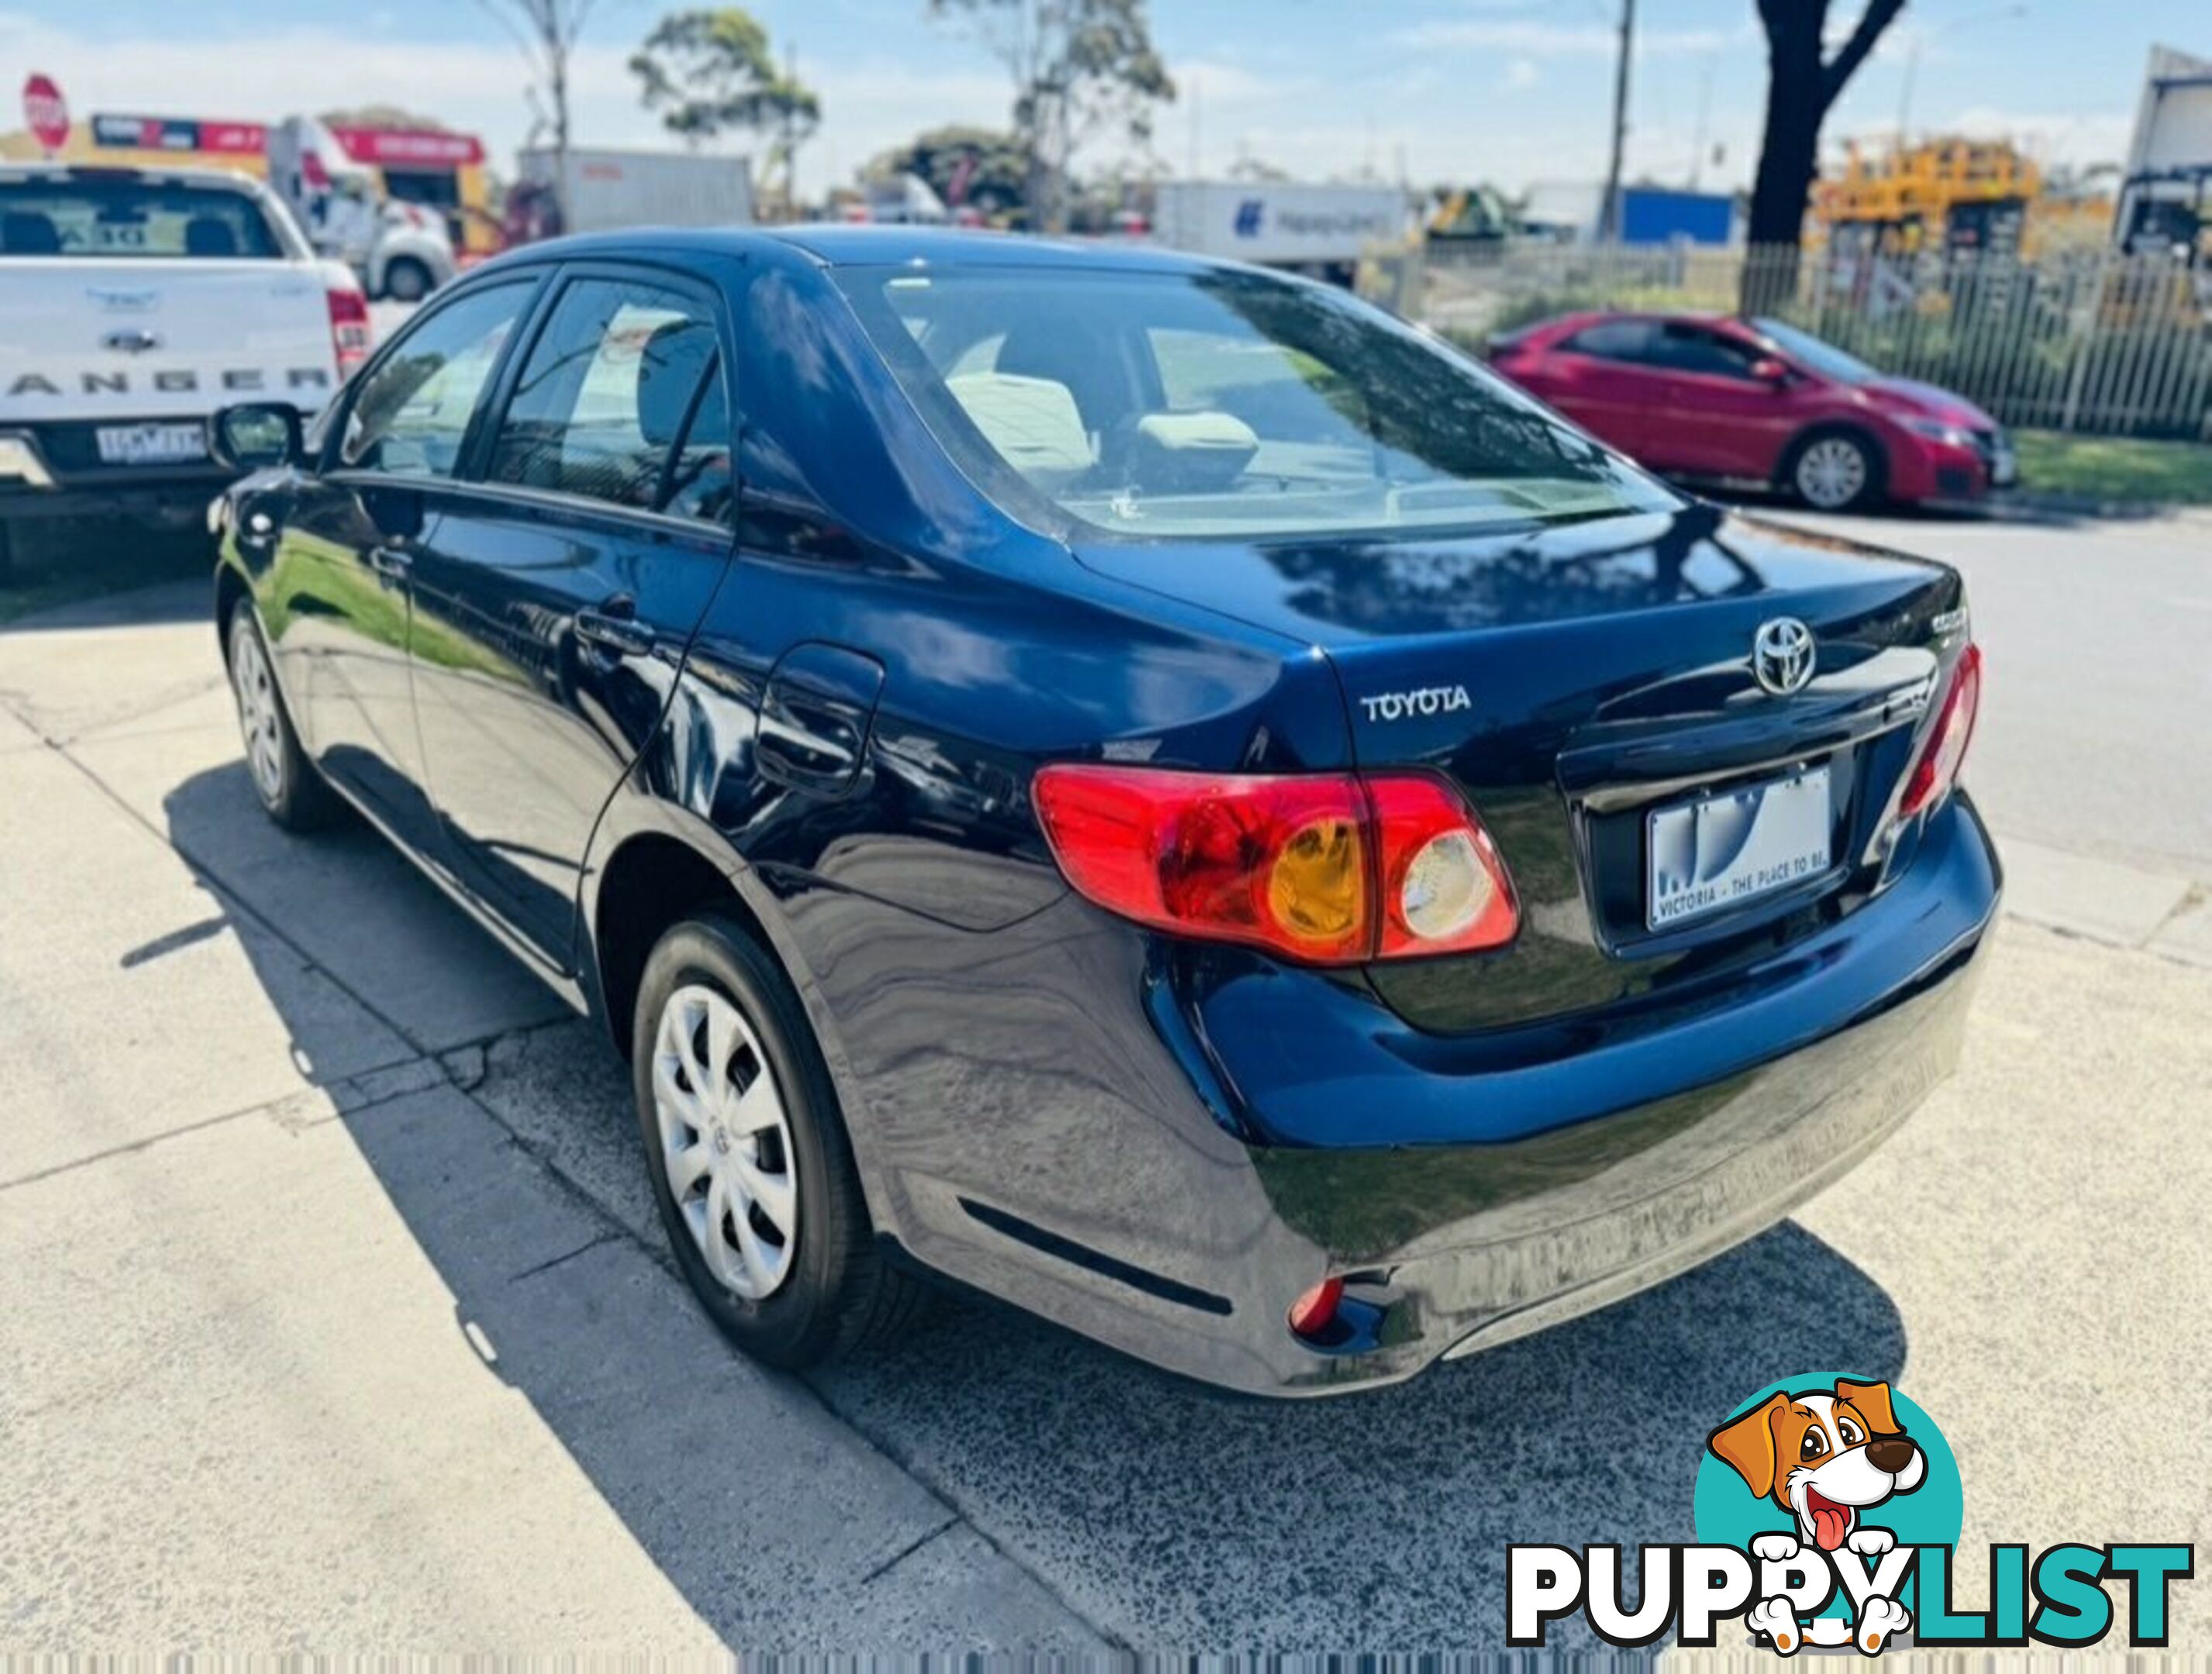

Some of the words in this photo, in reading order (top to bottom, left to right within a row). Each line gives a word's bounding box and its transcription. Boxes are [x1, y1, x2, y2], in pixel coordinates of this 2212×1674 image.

[1359, 684, 1472, 722] TOYOTA
[1659, 887, 1716, 917] VICTORIA
[1731, 877, 1754, 896] THE
[1758, 863, 1790, 885] PLACE
[1794, 856, 1807, 873] TO
